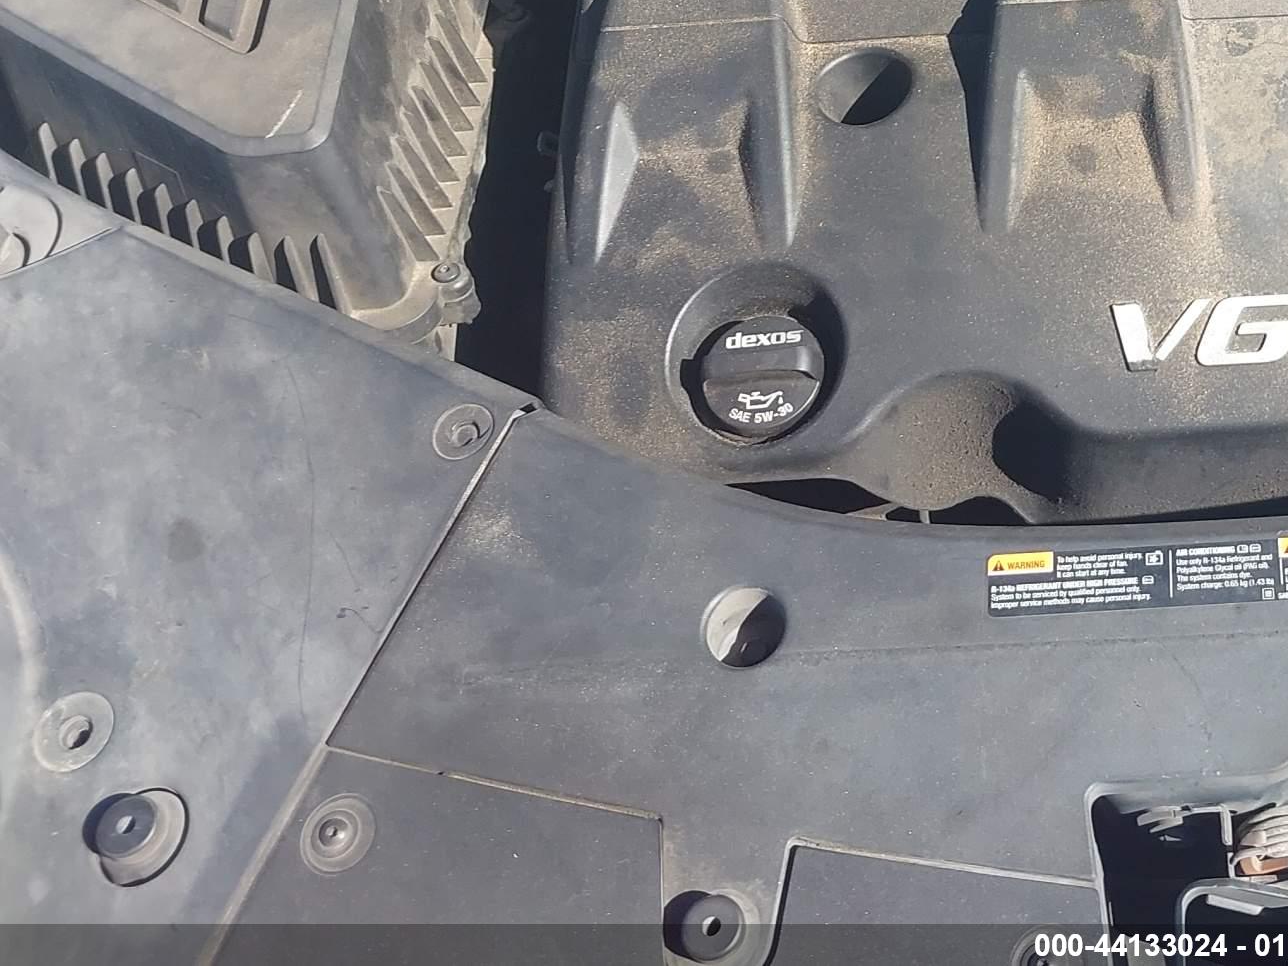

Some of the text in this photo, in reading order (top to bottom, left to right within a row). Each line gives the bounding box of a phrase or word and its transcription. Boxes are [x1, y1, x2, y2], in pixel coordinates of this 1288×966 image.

[726, 330, 804, 349] dexos
[729, 403, 793, 423] SAE 5W-30
[1189, 546, 1235, 555] CONDITIONING
[1066, 555, 1079, 563] help
[1098, 553, 1124, 561] personal
[1176, 558, 1188, 566] Use
[1189, 557, 1201, 566] only
[1203, 556, 1225, 564] R-134a
[1226, 554, 1259, 563] Refrigerant
[1007, 560, 1046, 570] WARNING
[1104, 577, 1138, 586] PRESSURE
[1189, 574, 1211, 582] system
[1213, 572, 1238, 580] contains
[1177, 583, 1200, 591] System
[1240, 579, 1248, 587] kg
[991, 593, 1014, 602] System
[1032, 590, 1058, 598] serviced
[1068, 588, 1094, 597] qualified
[1096, 586, 1125, 595] personnel
[1071, 597, 1084, 605] may
[1105, 594, 1131, 603] personal
